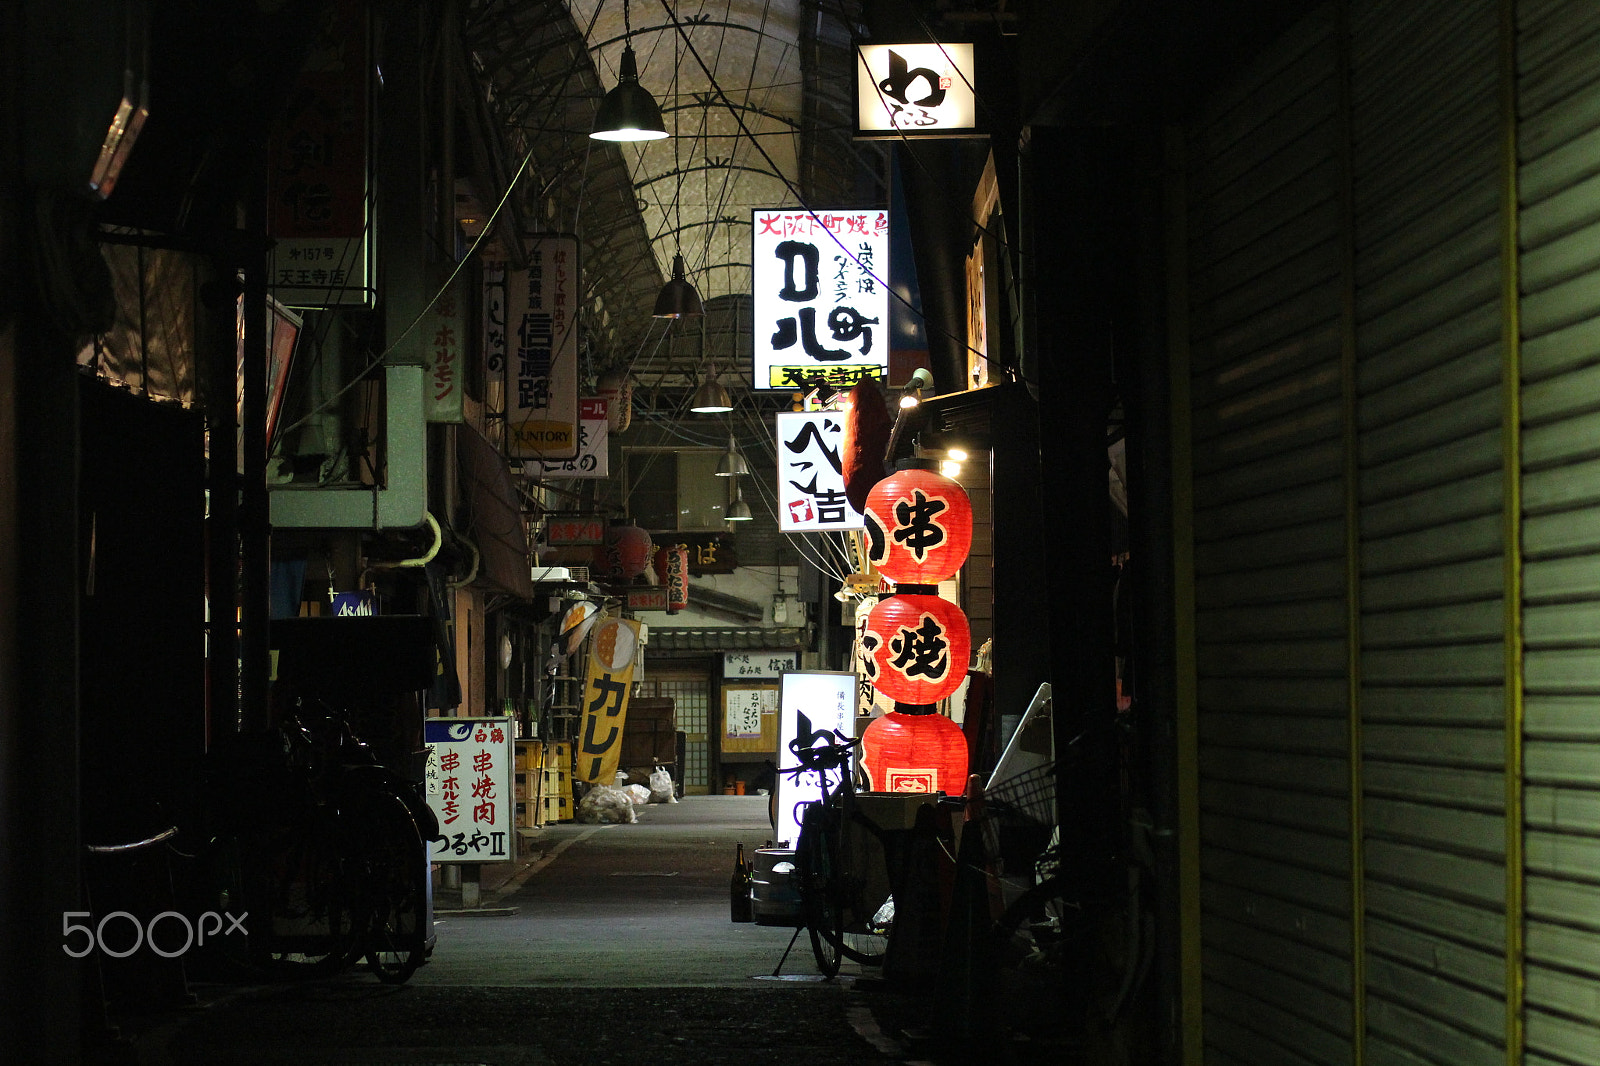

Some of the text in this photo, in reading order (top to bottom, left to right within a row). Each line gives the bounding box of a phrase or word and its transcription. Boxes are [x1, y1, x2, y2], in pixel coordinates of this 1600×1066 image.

[879, 49, 946, 107] わ
[279, 269, 345, 284] 天王寺店
[434, 325, 456, 402] ホルモン
[518, 313, 552, 409] 信濃路
[515, 431, 569, 442] SUNTORY
[581, 402, 606, 415] ール
[893, 489, 947, 561] 串
[337, 598, 372, 616] Asahi
[890, 615, 949, 681] 焼
[582, 673, 627, 781] カレー
[440, 748, 461, 825] 串ホルモン
[471, 748, 497, 826] 串焼肉
